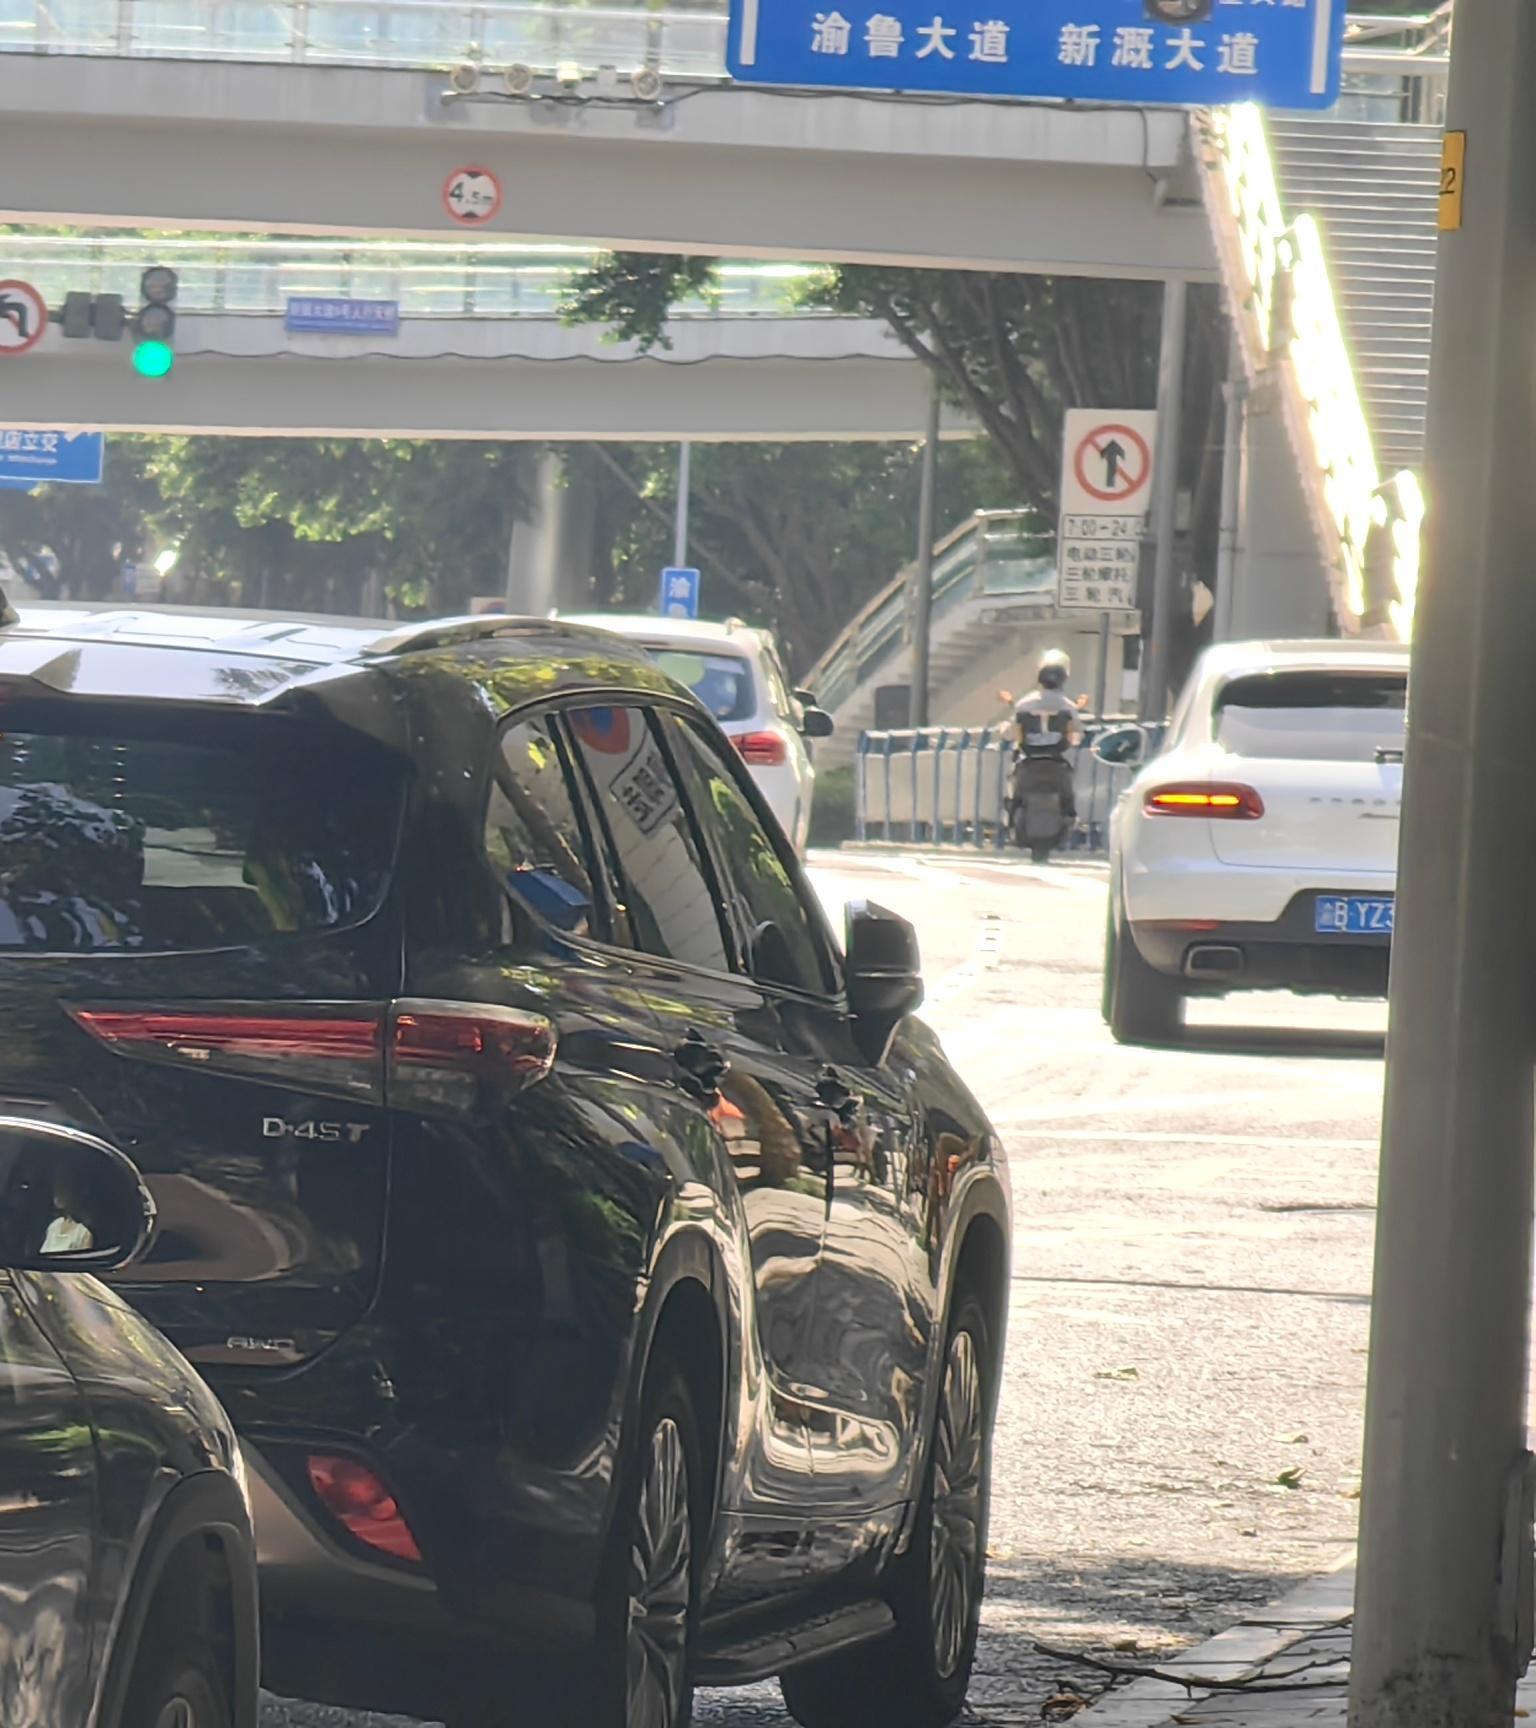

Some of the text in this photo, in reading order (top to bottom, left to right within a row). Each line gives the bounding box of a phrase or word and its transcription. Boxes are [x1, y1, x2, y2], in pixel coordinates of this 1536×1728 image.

[810, 11, 1260, 76] 渝鲁大道 新溉大道
